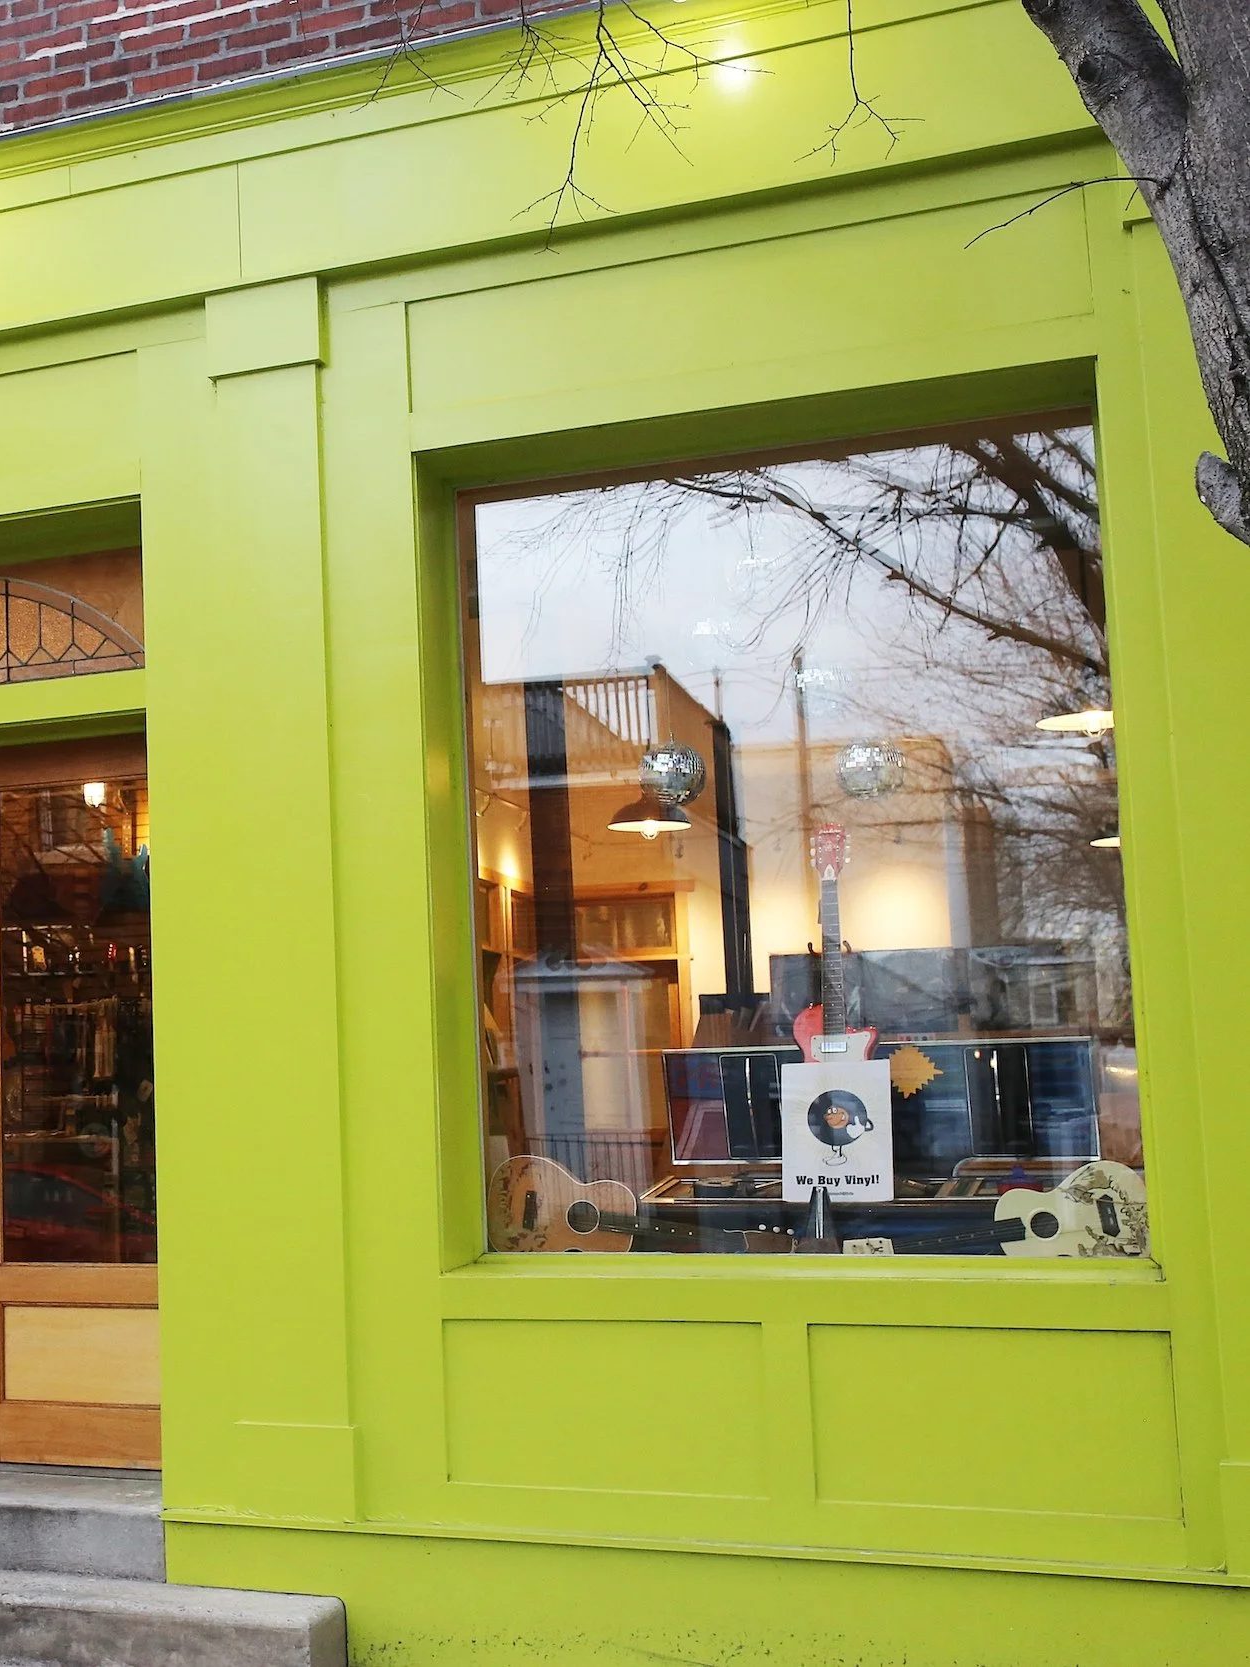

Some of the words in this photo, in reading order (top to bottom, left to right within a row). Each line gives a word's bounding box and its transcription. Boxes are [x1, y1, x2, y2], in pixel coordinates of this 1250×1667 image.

[795, 1175, 814, 1185] We
[817, 1175, 841, 1187] Buy
[844, 1174, 880, 1187] Vinyl!
